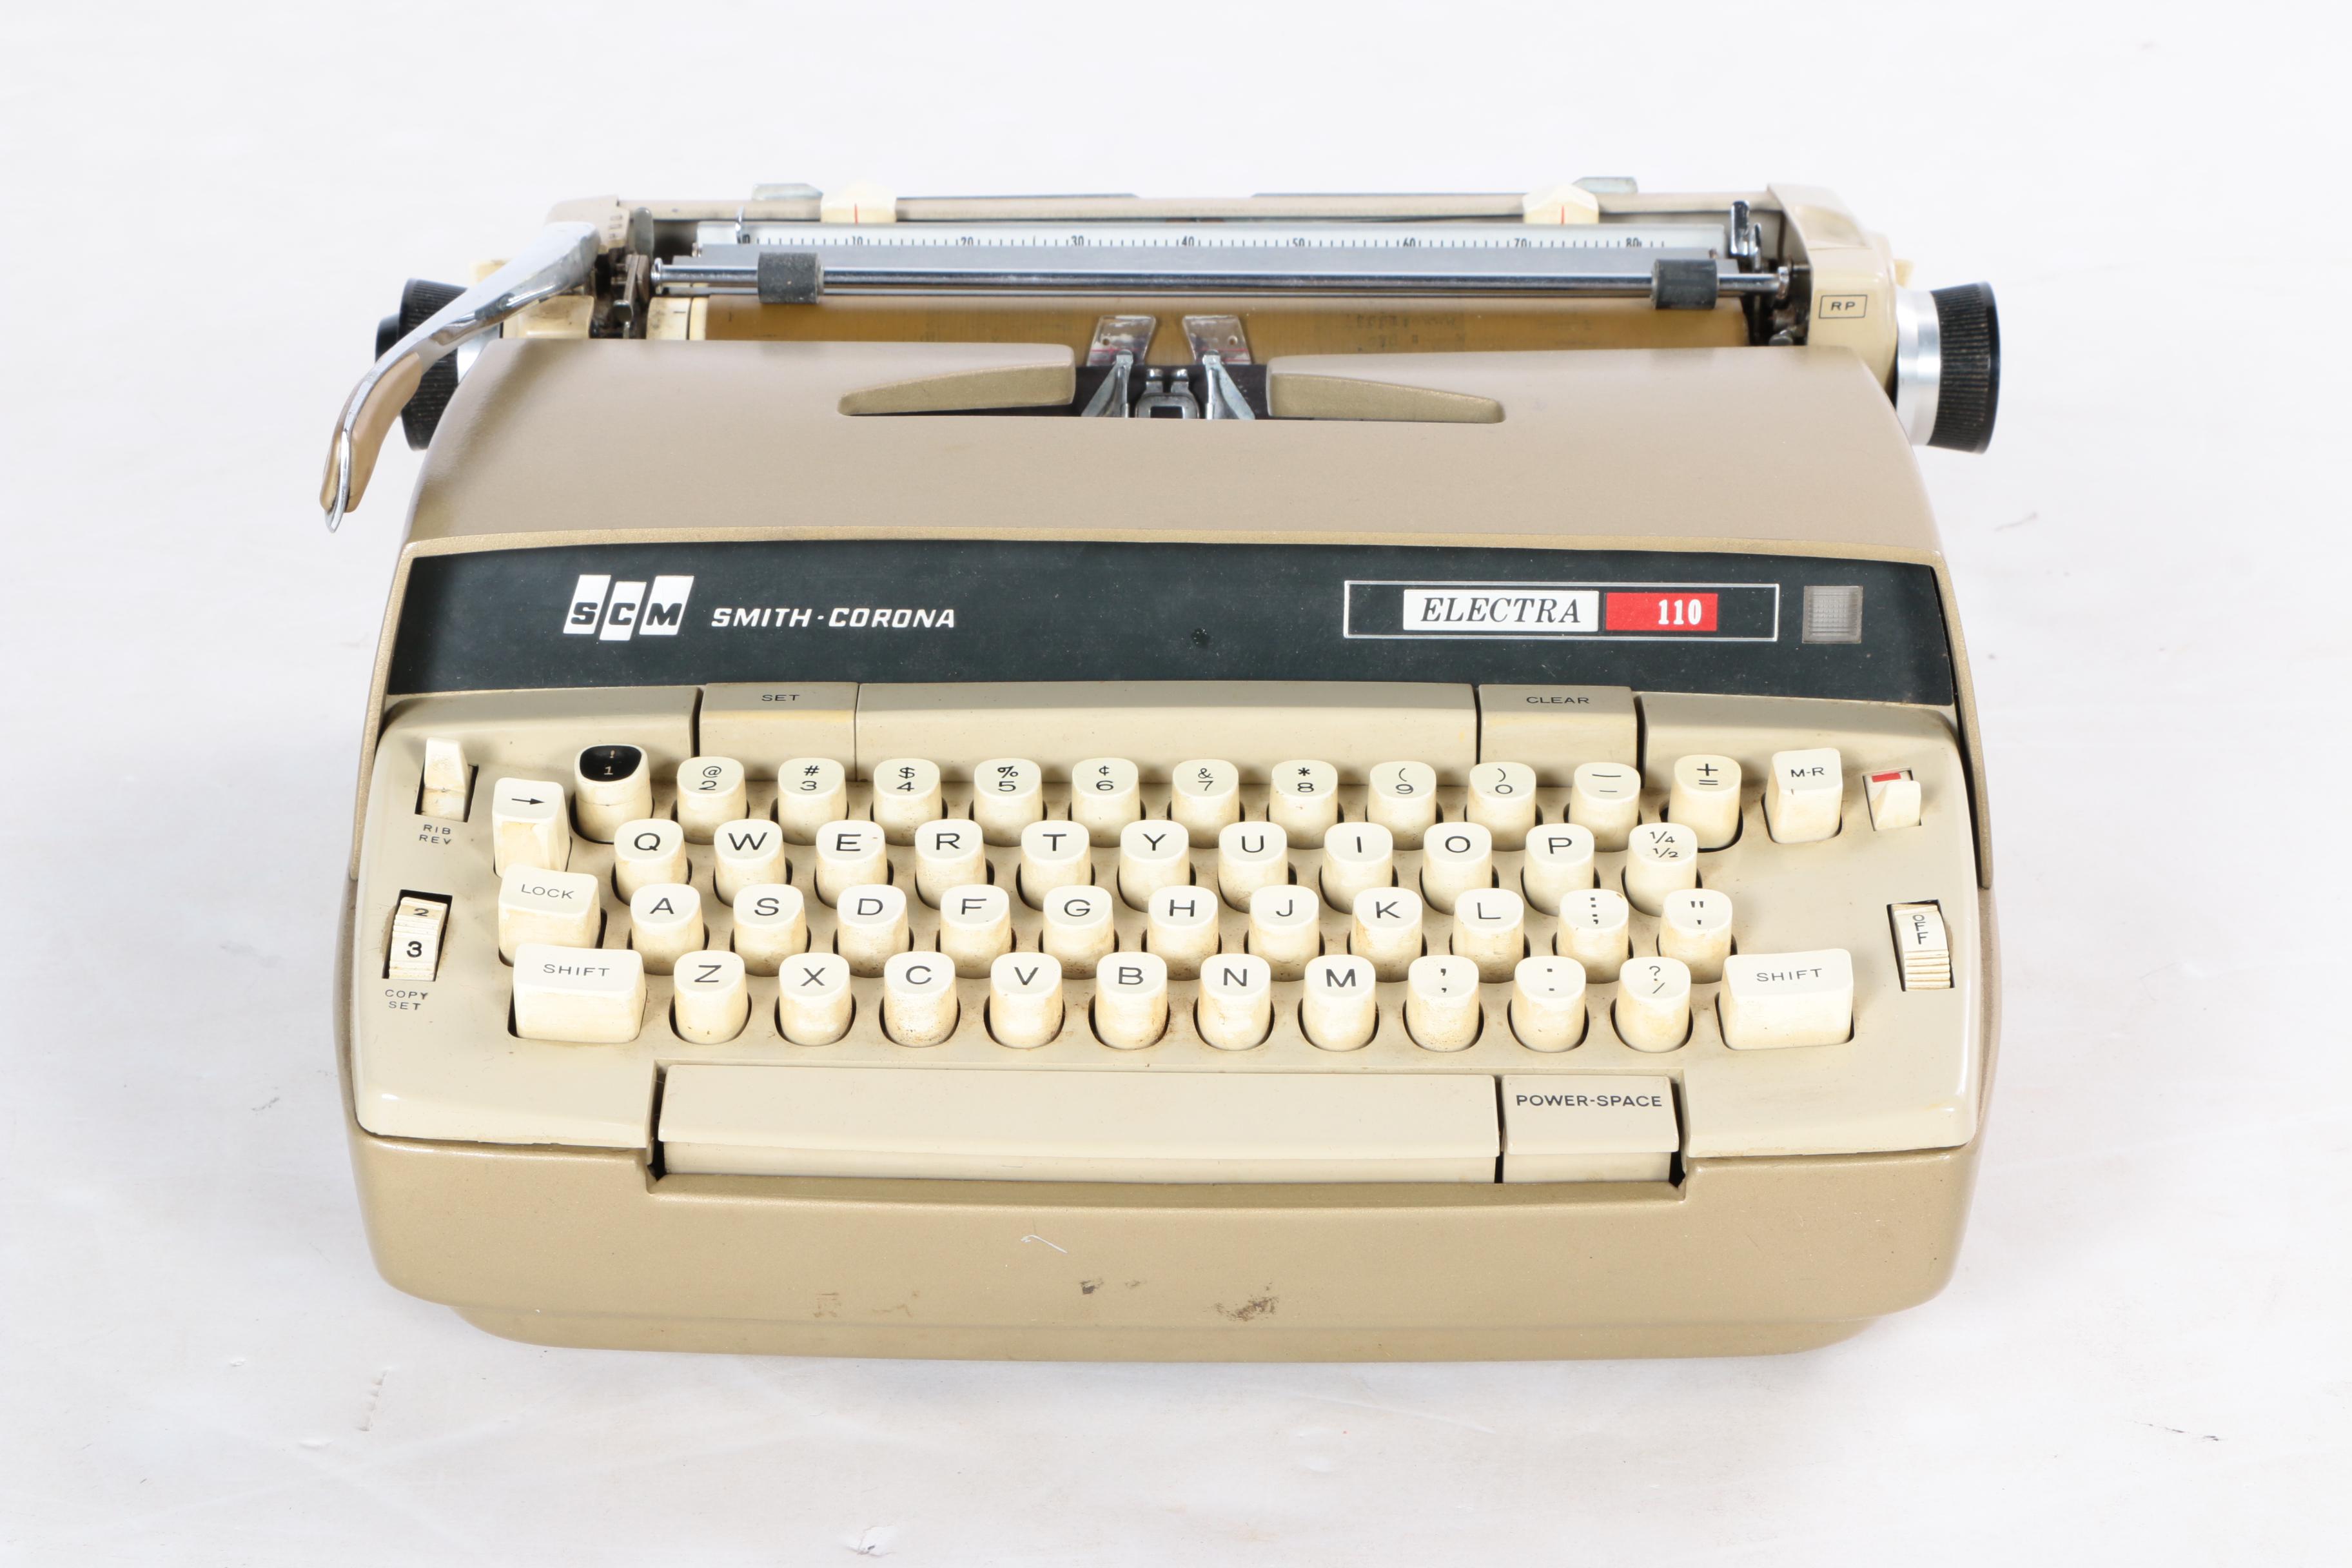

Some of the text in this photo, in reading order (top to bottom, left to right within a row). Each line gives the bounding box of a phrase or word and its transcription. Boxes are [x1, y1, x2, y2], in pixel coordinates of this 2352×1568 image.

[1830, 302, 1856, 311] RP
[570, 602, 683, 626] SCM
[1420, 597, 1702, 625] ELECTRA 110
[610, 750, 615, 759] !
[603, 766, 614, 775] 1
[702, 765, 722, 778] @
[804, 765, 819, 776] #
[898, 767, 915, 779] $
[997, 765, 1019, 779] %
[1099, 765, 1110, 776] ¢
[1197, 768, 1213, 779] &
[1790, 767, 1825, 778] M-R
[698, 780, 717, 790] 2
[800, 780, 817, 791] 3
[896, 781, 914, 792] 4
[998, 781, 1017, 792] 5
[1095, 780, 1114, 791] 6
[1198, 780, 1213, 791] 7
[1297, 782, 1315, 793] 8
[1395, 783, 1414, 795] 9
[423, 824, 451, 834] RIB
[419, 834, 452, 845] REV
[634, 832, 661, 852] Q
[728, 832, 767, 851] W
[836, 833, 861, 852] E
[936, 832, 960, 850] R
[1043, 834, 1067, 852] T
[1142, 834, 1166, 852] Y
[1241, 835, 1264, 853] U
[1445, 836, 1471, 854] O
[1548, 837, 1573, 854] P
[521, 883, 574, 899] LOCK
[413, 908, 429, 917] 2
[649, 897, 674, 915] A
[754, 897, 779, 916] S
[857, 898, 883, 916] D
[961, 898, 987, 915] F
[1064, 899, 1091, 917] G
[1169, 899, 1195, 917] H
[1275, 899, 1293, 917] J
[1375, 901, 1401, 919] K
[1477, 902, 1502, 920] L
[1912, 914, 1928, 945] OFF
[406, 941, 422, 958] 3
[543, 964, 610, 977] SHIFT
[694, 965, 722, 983] Z
[800, 967, 826, 986] X
[905, 965, 932, 985] C
[1014, 966, 1039, 986] V
[1118, 966, 1144, 985] B
[1223, 968, 1248, 987] N
[1326, 968, 1357, 988] M
[1756, 968, 1822, 982] SHIFT
[385, 989, 428, 1000] COPY
[389, 1001, 421, 1010] SET
[1516, 1095, 1662, 1107] POWER-SPACE
